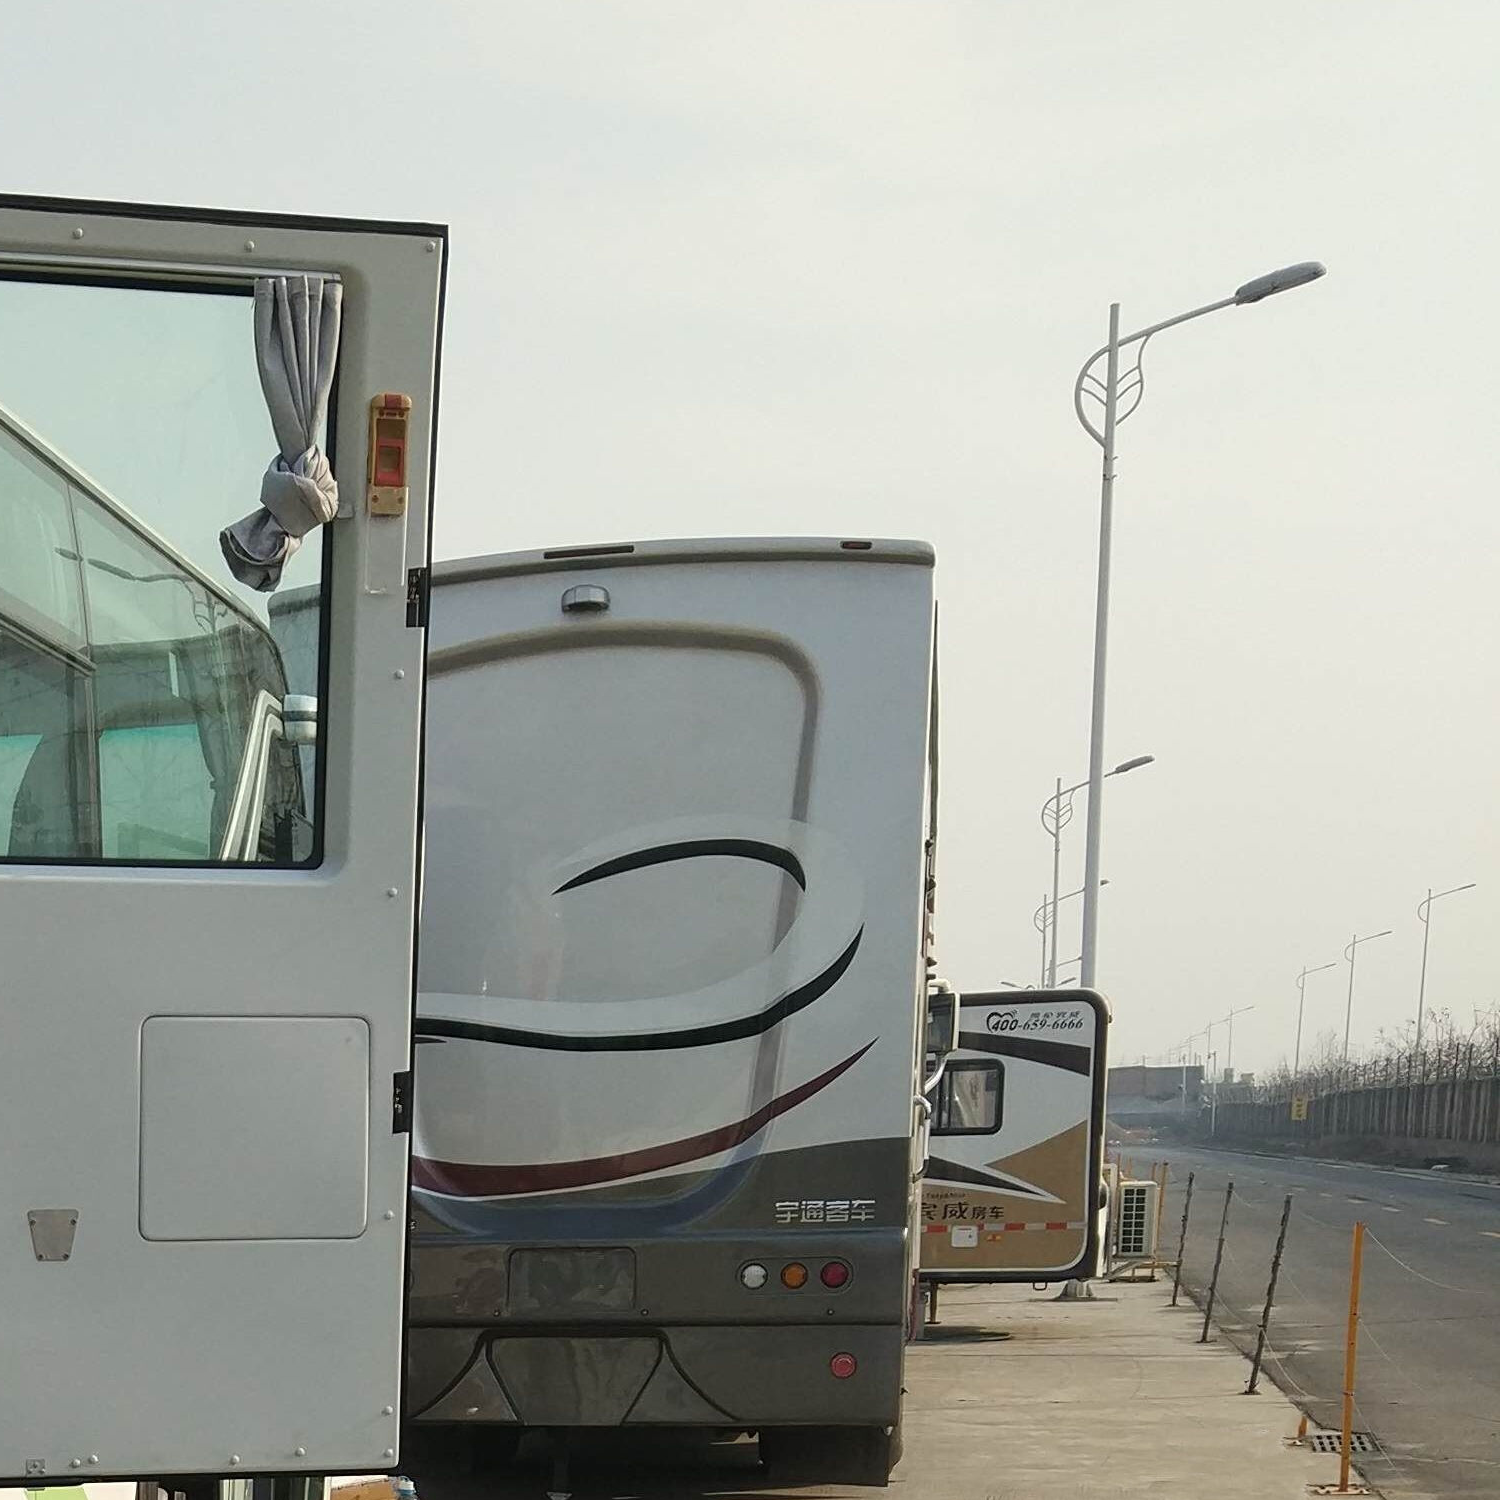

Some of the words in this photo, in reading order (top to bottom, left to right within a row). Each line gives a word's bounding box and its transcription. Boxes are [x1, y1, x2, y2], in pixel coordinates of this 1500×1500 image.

[991, 1018, 1084, 1031] 400-659-6666
[775, 1200, 876, 1222] 宇通客车
